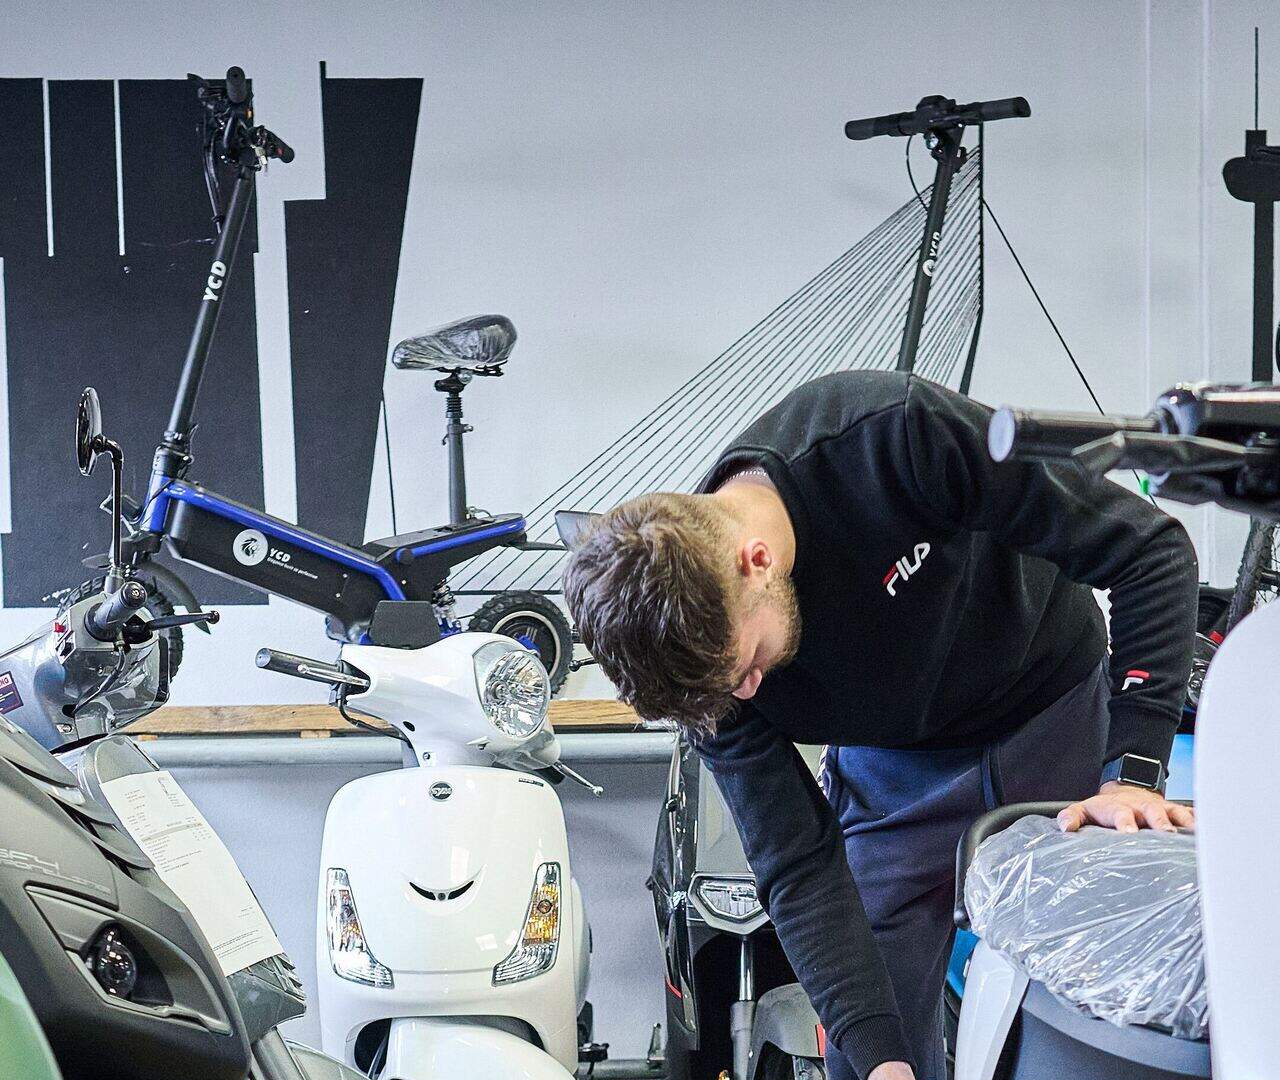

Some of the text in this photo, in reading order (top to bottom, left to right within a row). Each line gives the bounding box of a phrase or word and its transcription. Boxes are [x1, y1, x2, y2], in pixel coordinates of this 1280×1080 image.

[203, 260, 226, 301] YCD
[270, 547, 291, 562] YCD
[882, 542, 931, 597] FILA
